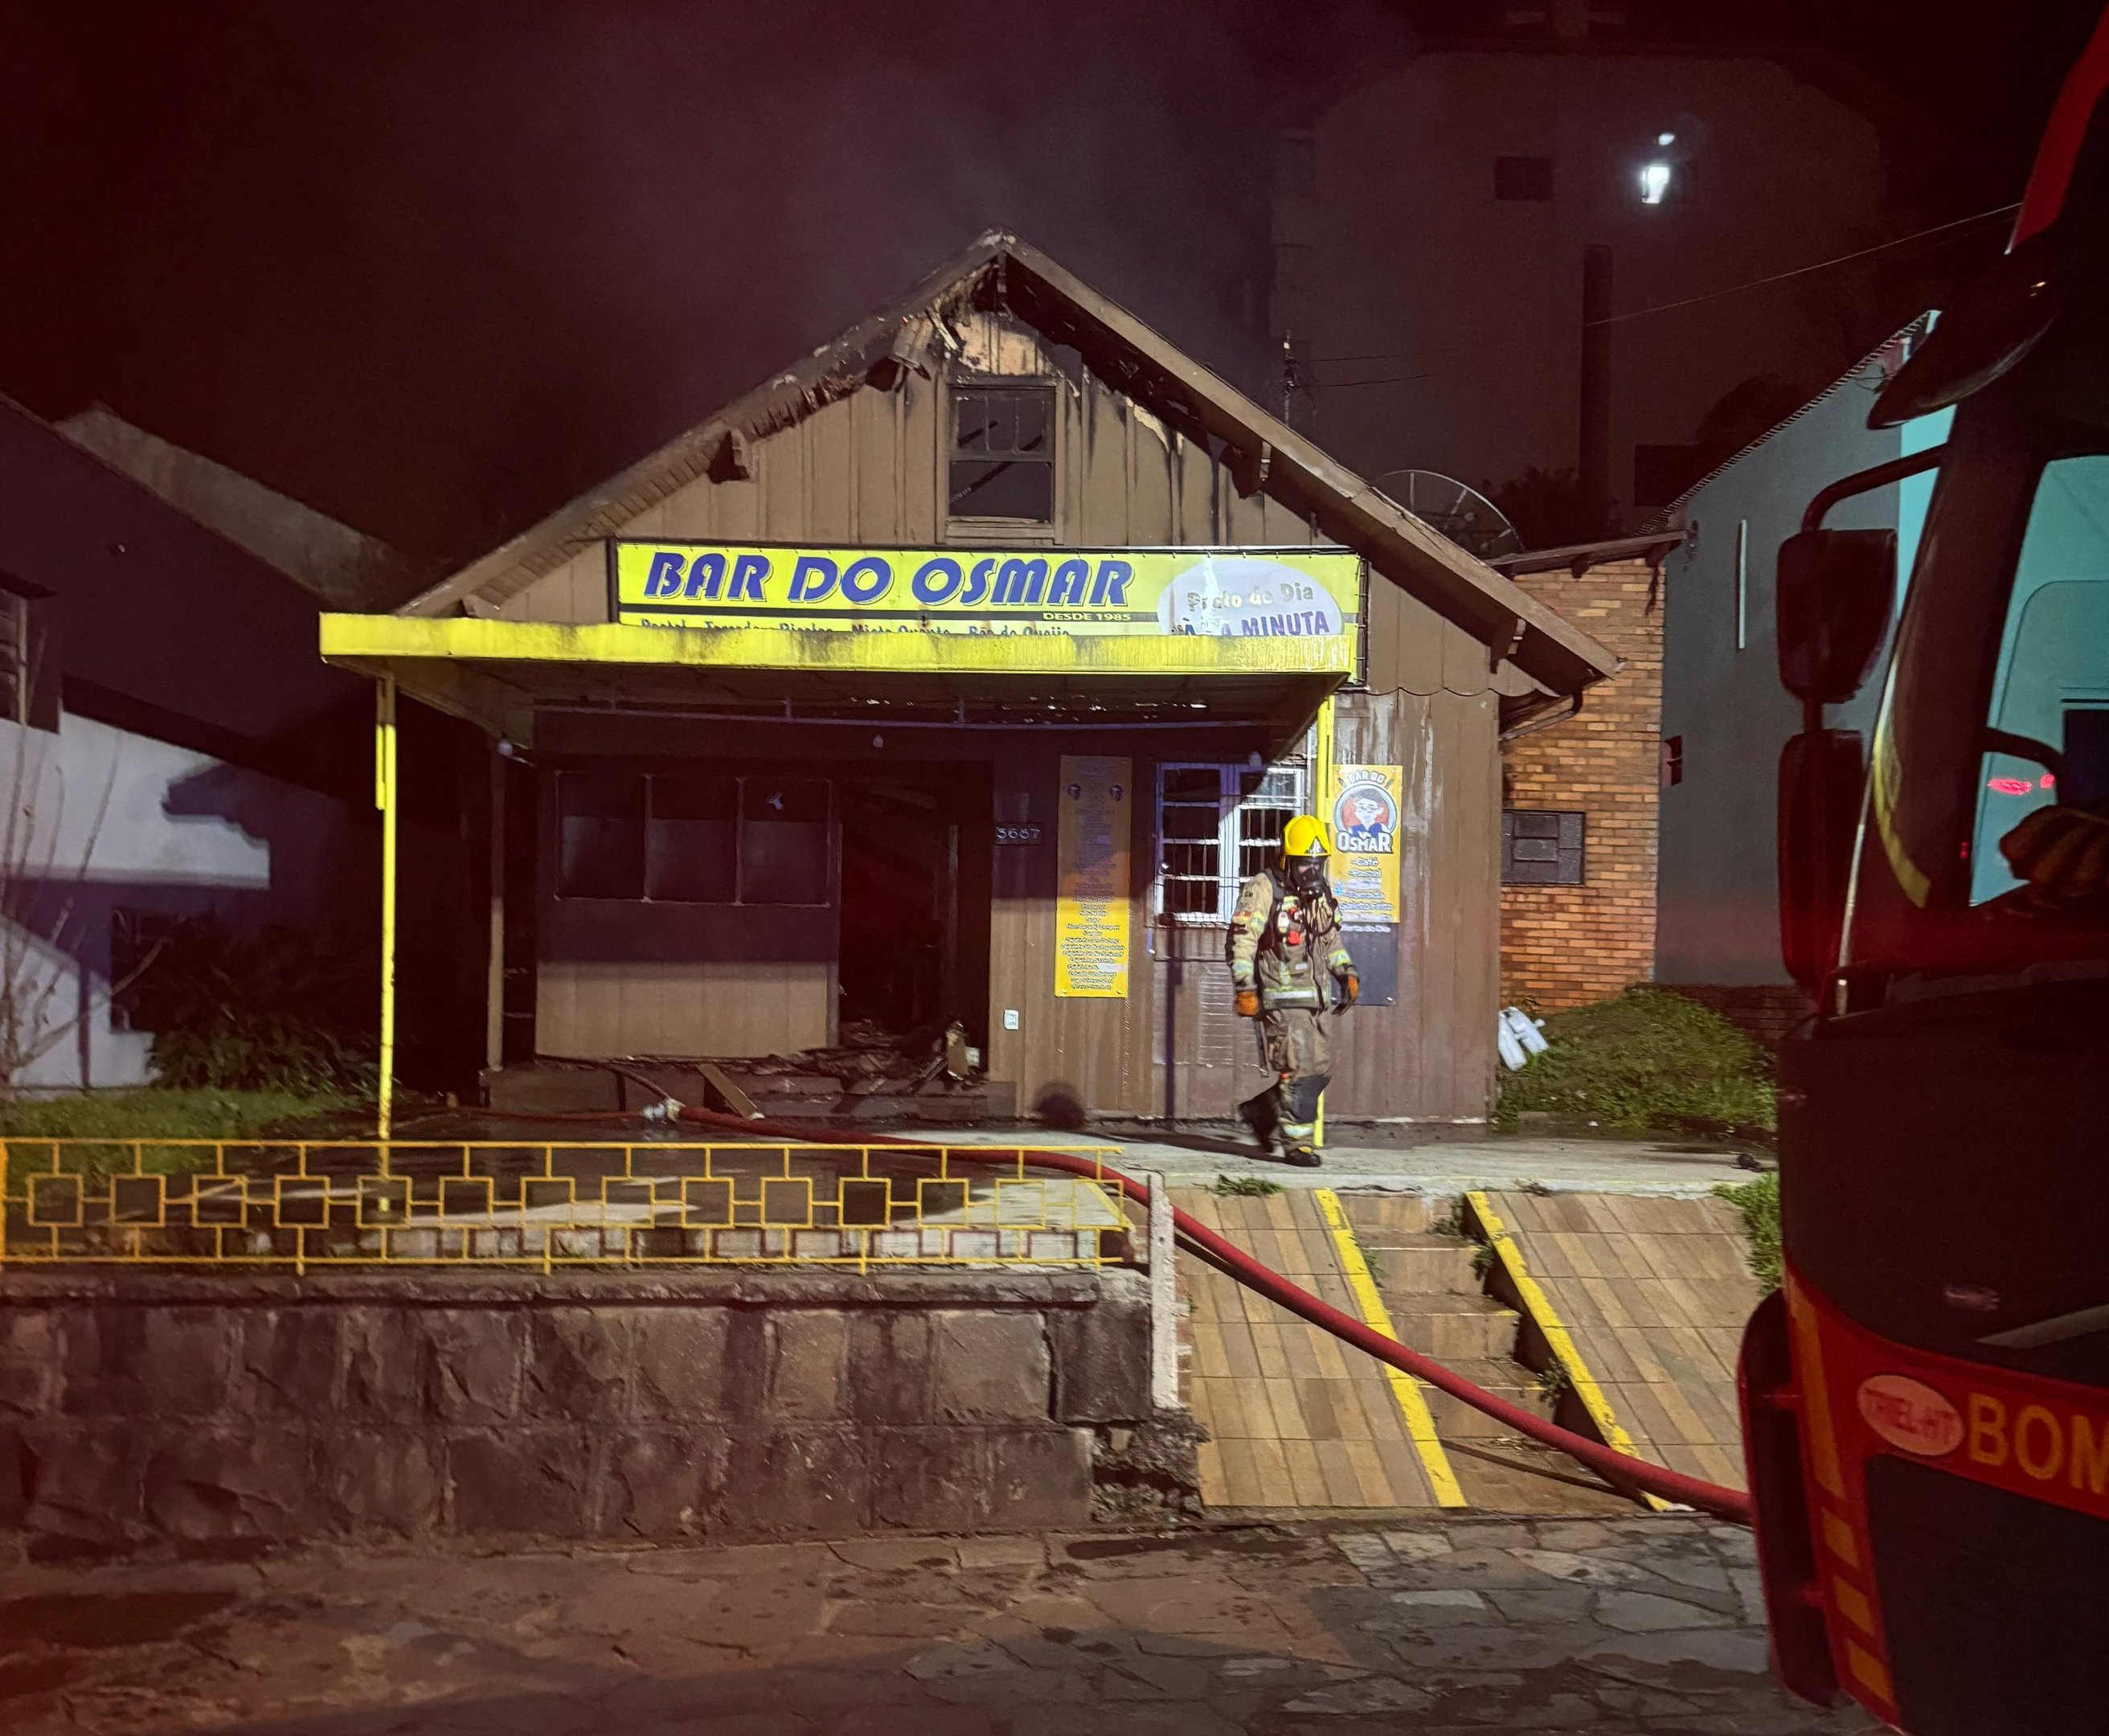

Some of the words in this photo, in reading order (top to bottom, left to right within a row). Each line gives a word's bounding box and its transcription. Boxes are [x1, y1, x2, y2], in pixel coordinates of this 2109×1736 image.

[644, 552, 774, 602] BAR
[787, 556, 895, 605] DO
[911, 557, 1135, 608] OSMAR
[1280, 582, 1314, 603] Dia
[1043, 612, 1091, 621] DESDE
[1095, 613, 1132, 621] 1985
[1241, 611, 1329, 636] MINUTA
[1337, 829, 1393, 853] OSMAR
